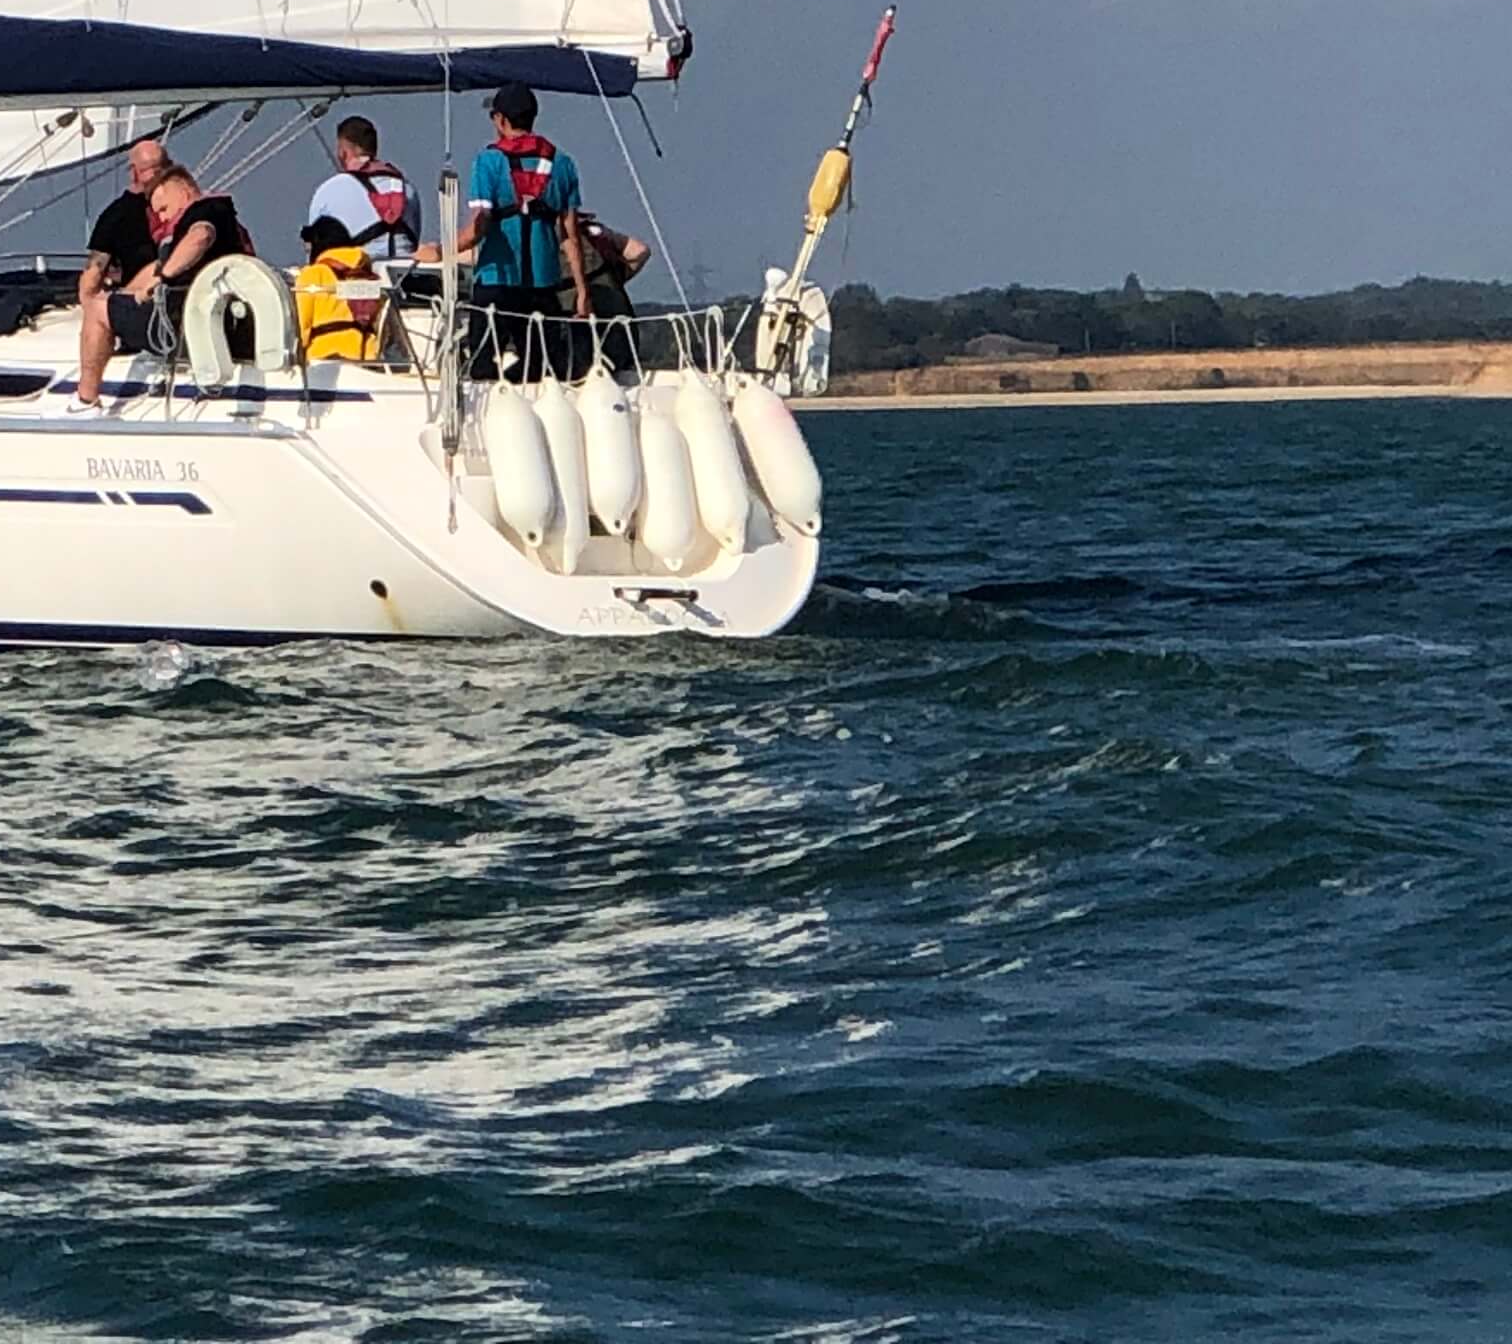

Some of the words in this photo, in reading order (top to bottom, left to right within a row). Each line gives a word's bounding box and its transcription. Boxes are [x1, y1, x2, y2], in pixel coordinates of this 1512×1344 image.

[87, 457, 165, 481] BAVARIA
[176, 461, 199, 481] 36
[576, 606, 734, 626] APPAOA
